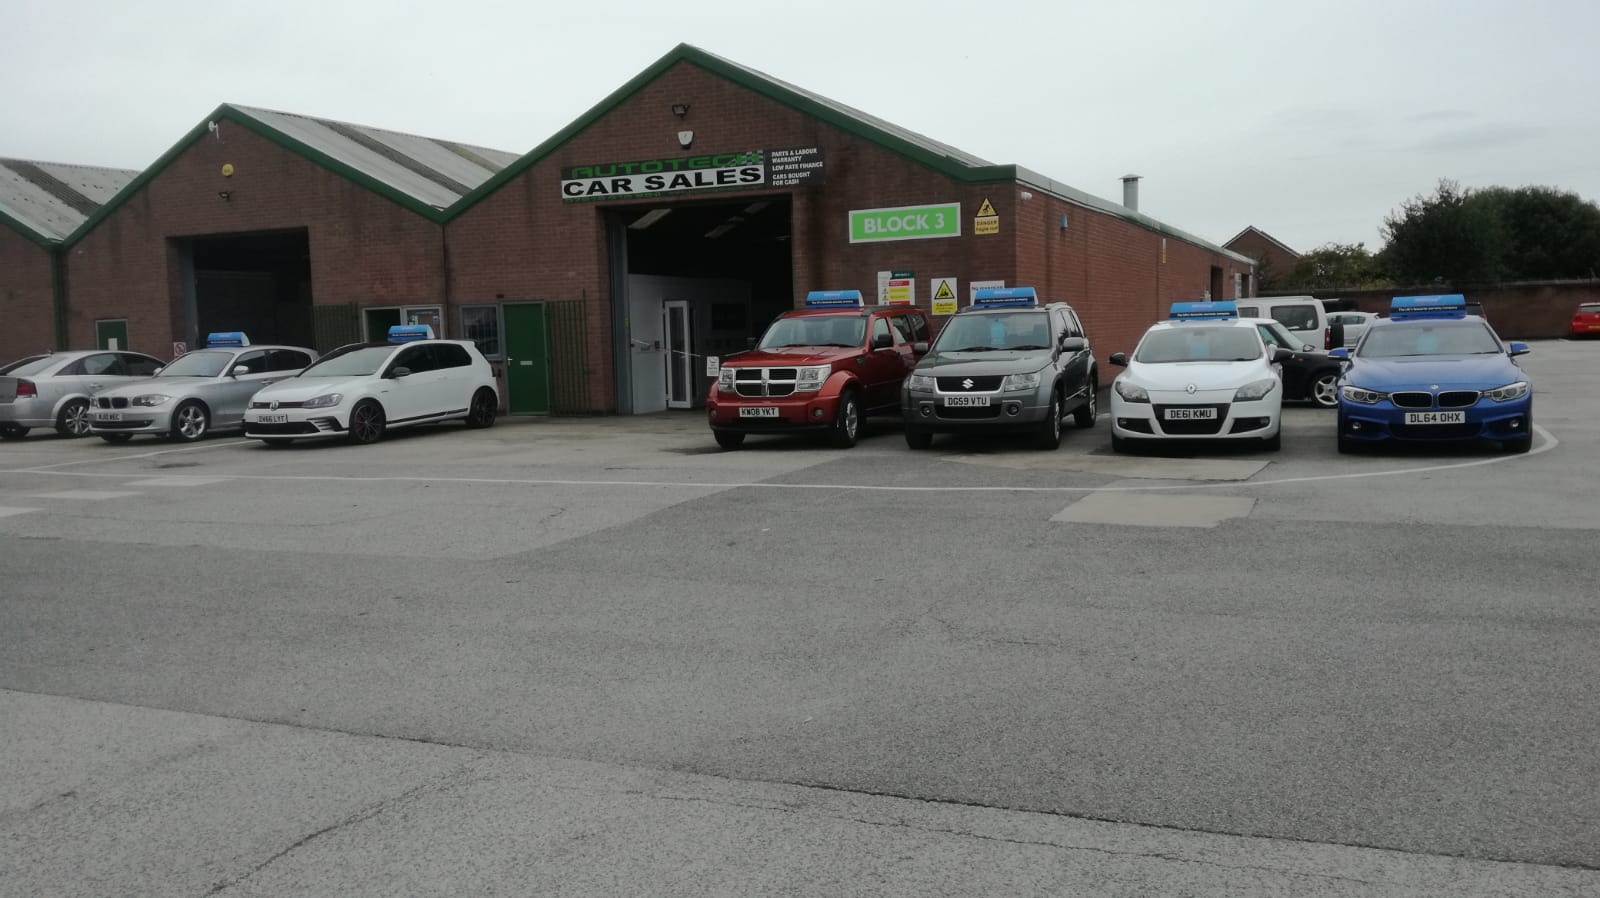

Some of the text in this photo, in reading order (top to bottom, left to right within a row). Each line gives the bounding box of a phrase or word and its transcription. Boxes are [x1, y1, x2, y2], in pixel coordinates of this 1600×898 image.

[572, 151, 759, 178] AUTOTECH
[788, 171, 810, 179] BOUGHT
[563, 178, 632, 196] CAR
[644, 168, 761, 190] SALES
[864, 213, 944, 233] BLOCK 3
[948, 397, 987, 406] DG59 VTU
[761, 407, 775, 416] YKT
[1170, 409, 1211, 418] DE61 KMU
[1410, 413, 1460, 422] DL64 OHX
